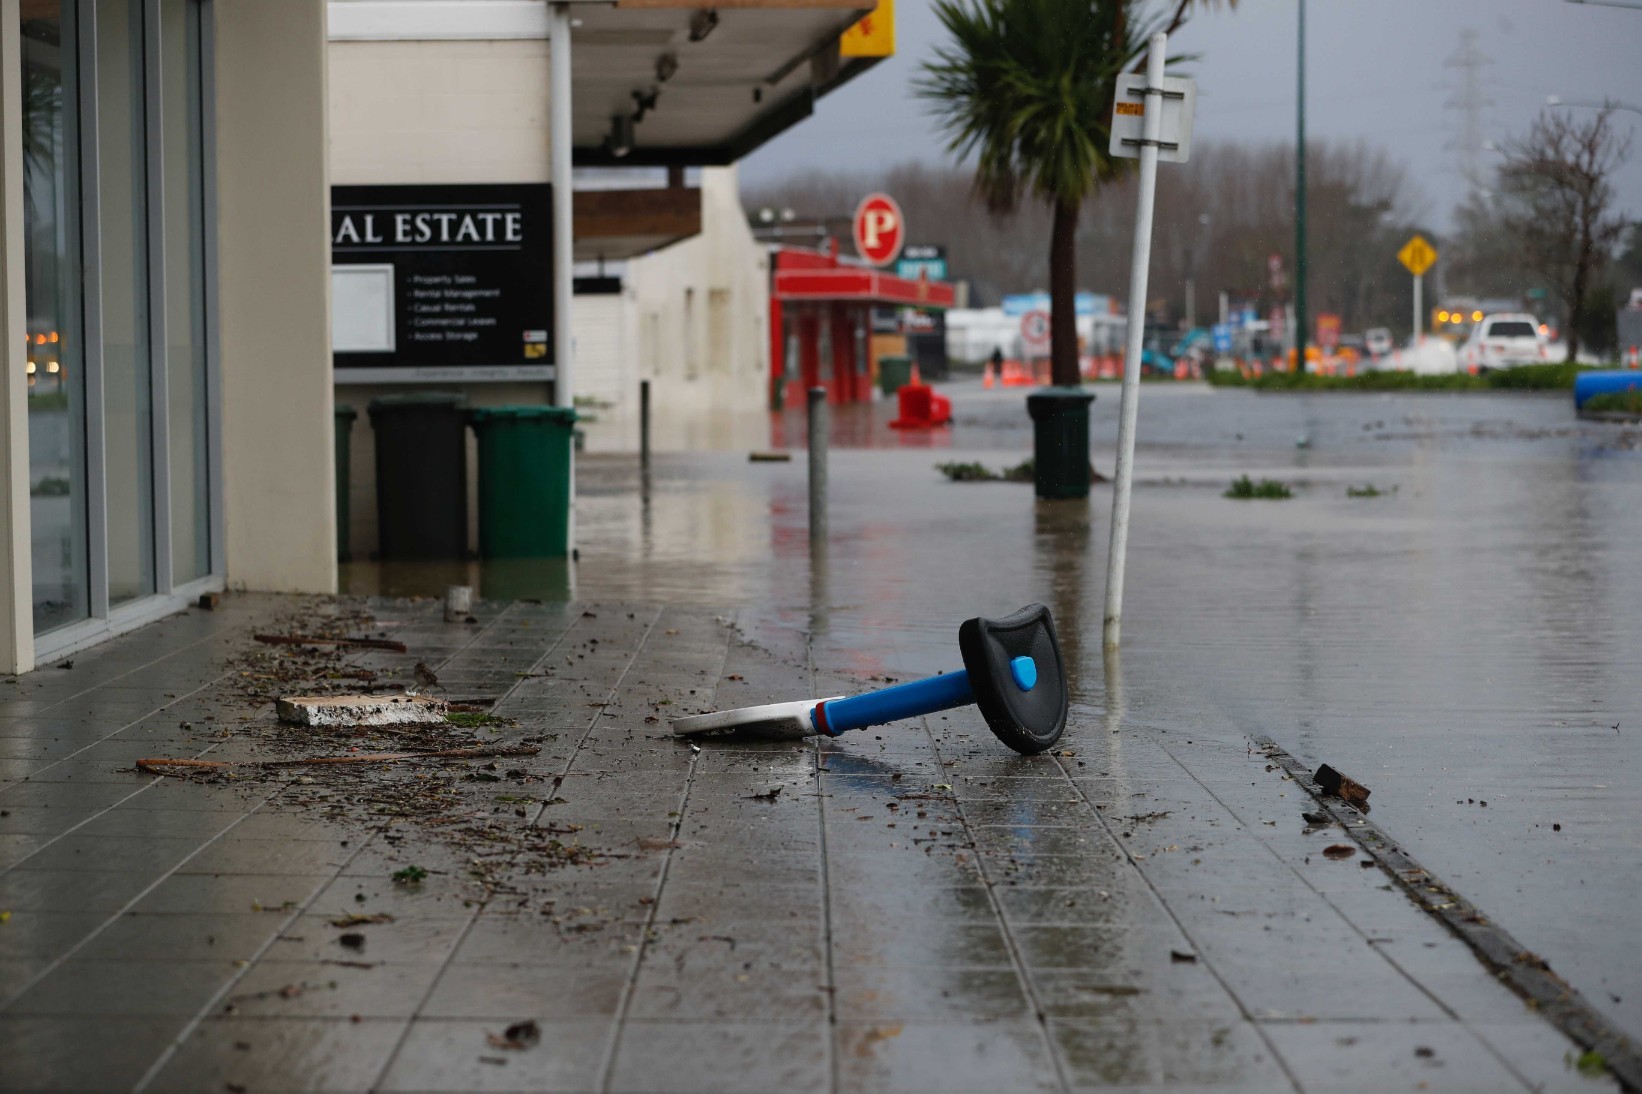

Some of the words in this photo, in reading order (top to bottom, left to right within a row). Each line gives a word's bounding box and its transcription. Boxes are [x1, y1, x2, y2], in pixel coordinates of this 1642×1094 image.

[331, 213, 383, 243] AL
[394, 212, 523, 243] ESTATE
[863, 209, 898, 250] P
[413, 274, 452, 285] Property
[454, 274, 477, 284] Sales
[413, 288, 441, 298] Rental
[443, 287, 500, 299] Management
[413, 303, 441, 313] Casual
[443, 302, 476, 312] Rentals
[413, 316, 466, 326] Commercial
[444, 331, 479, 342] Storage
